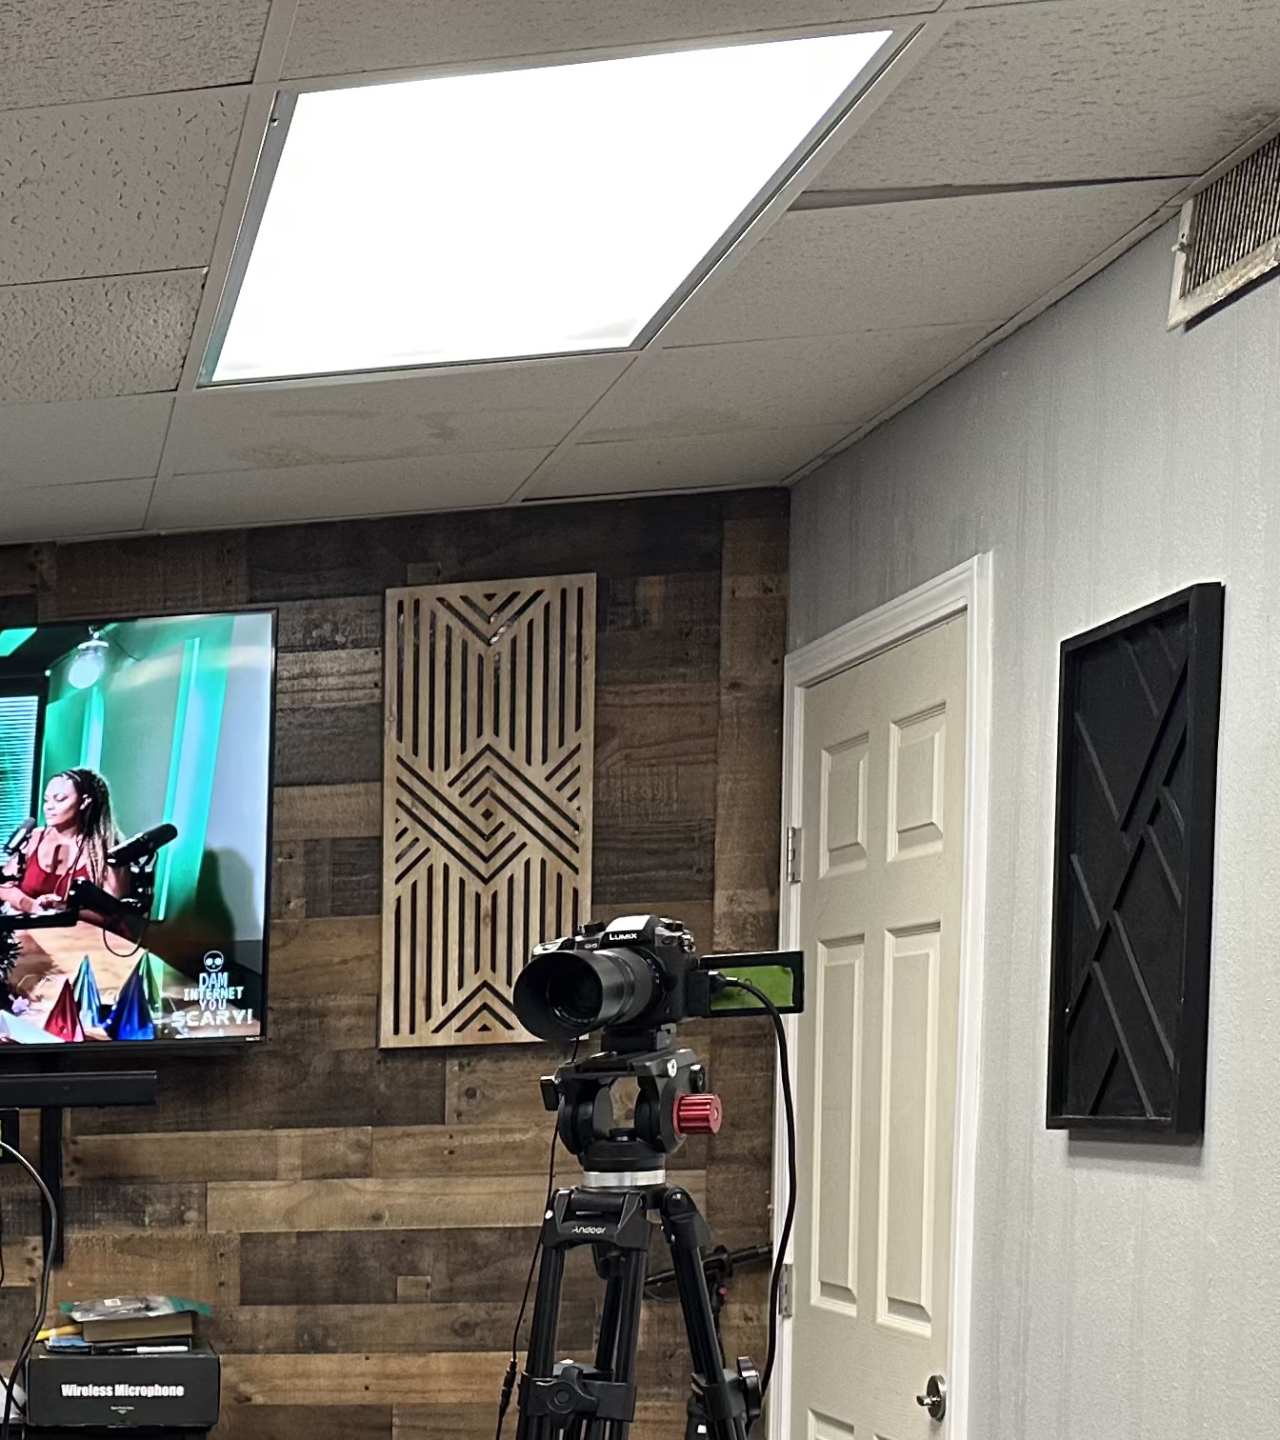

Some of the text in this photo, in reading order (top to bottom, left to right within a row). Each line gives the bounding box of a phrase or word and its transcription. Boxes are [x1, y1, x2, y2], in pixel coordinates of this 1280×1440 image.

[198, 972, 229, 988] DAM
[183, 986, 244, 1001] INTERNET
[198, 999, 227, 1011] YOU
[171, 1009, 254, 1027] SCARY!
[61, 1384, 185, 1398] Wireless Microphone
